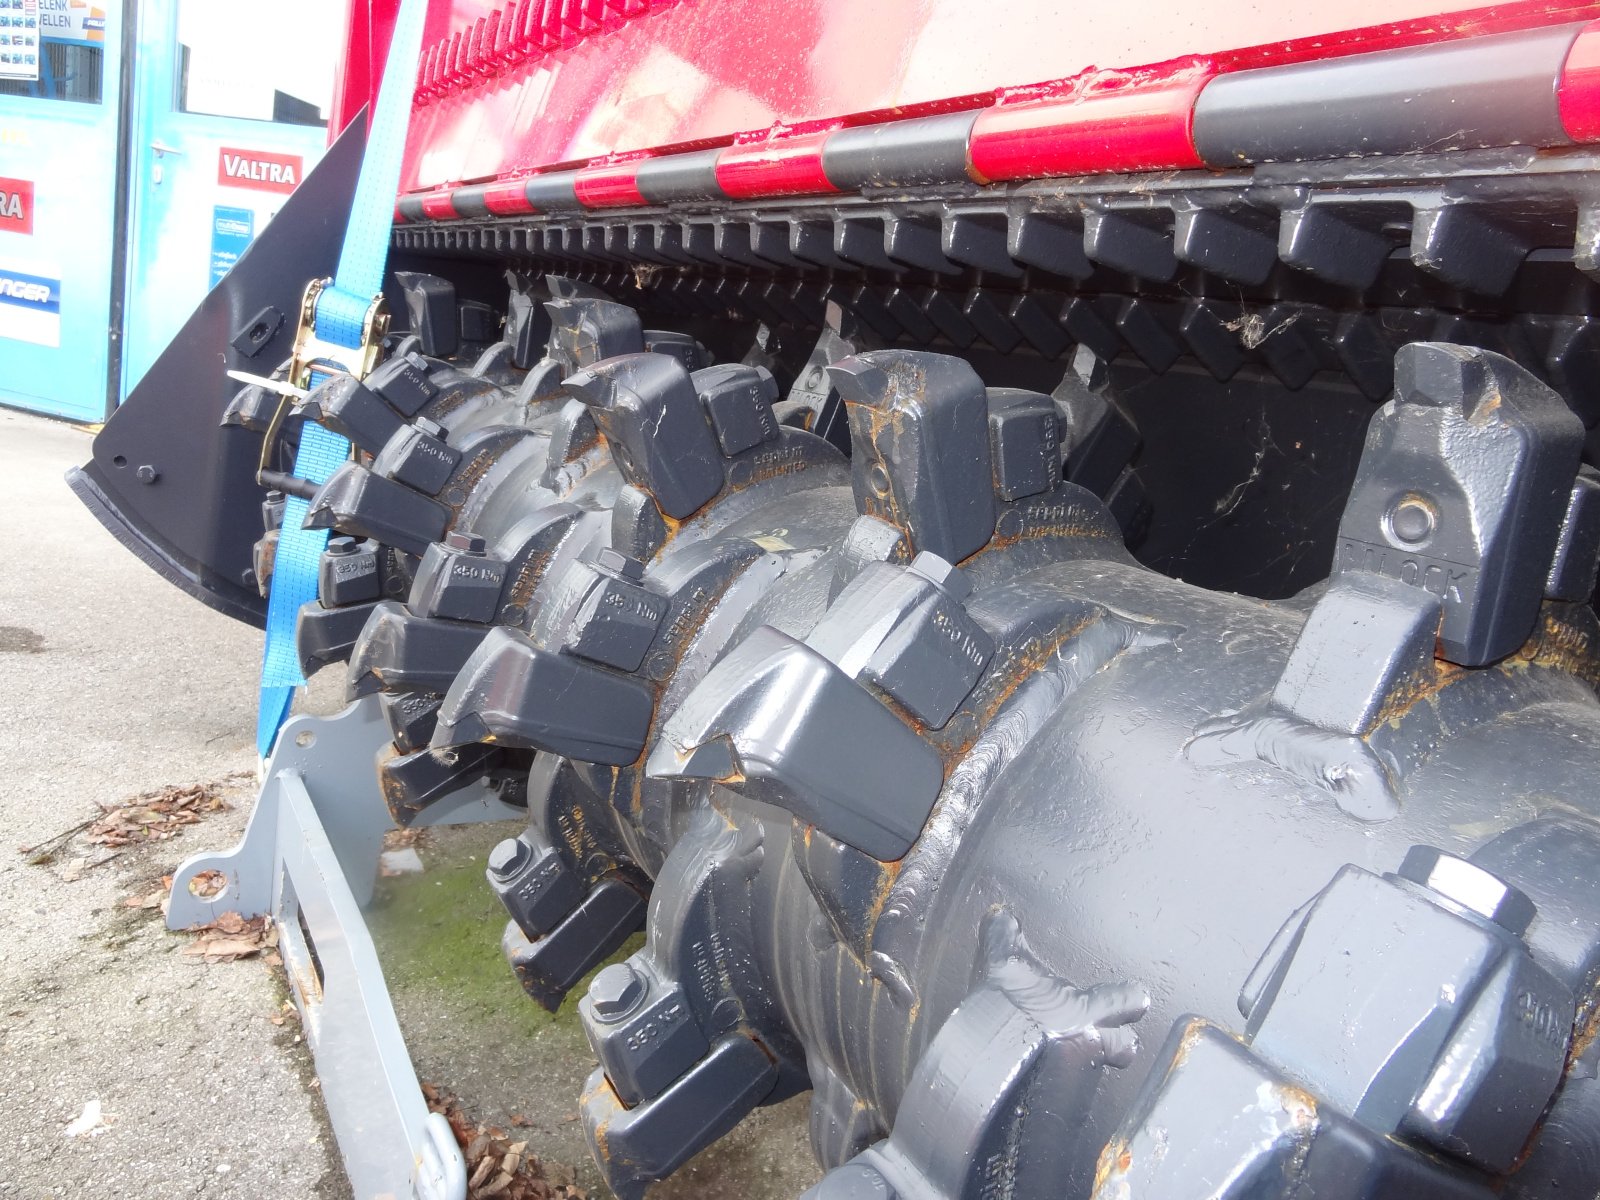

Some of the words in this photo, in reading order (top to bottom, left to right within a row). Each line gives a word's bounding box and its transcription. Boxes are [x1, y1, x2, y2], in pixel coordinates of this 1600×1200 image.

[39, 13, 71, 28] ELLEN
[223, 154, 296, 185] VALTRA
[0, 277, 51, 303] NGER
[636, 601, 657, 622] Nm
[626, 1022, 658, 1051] 350
